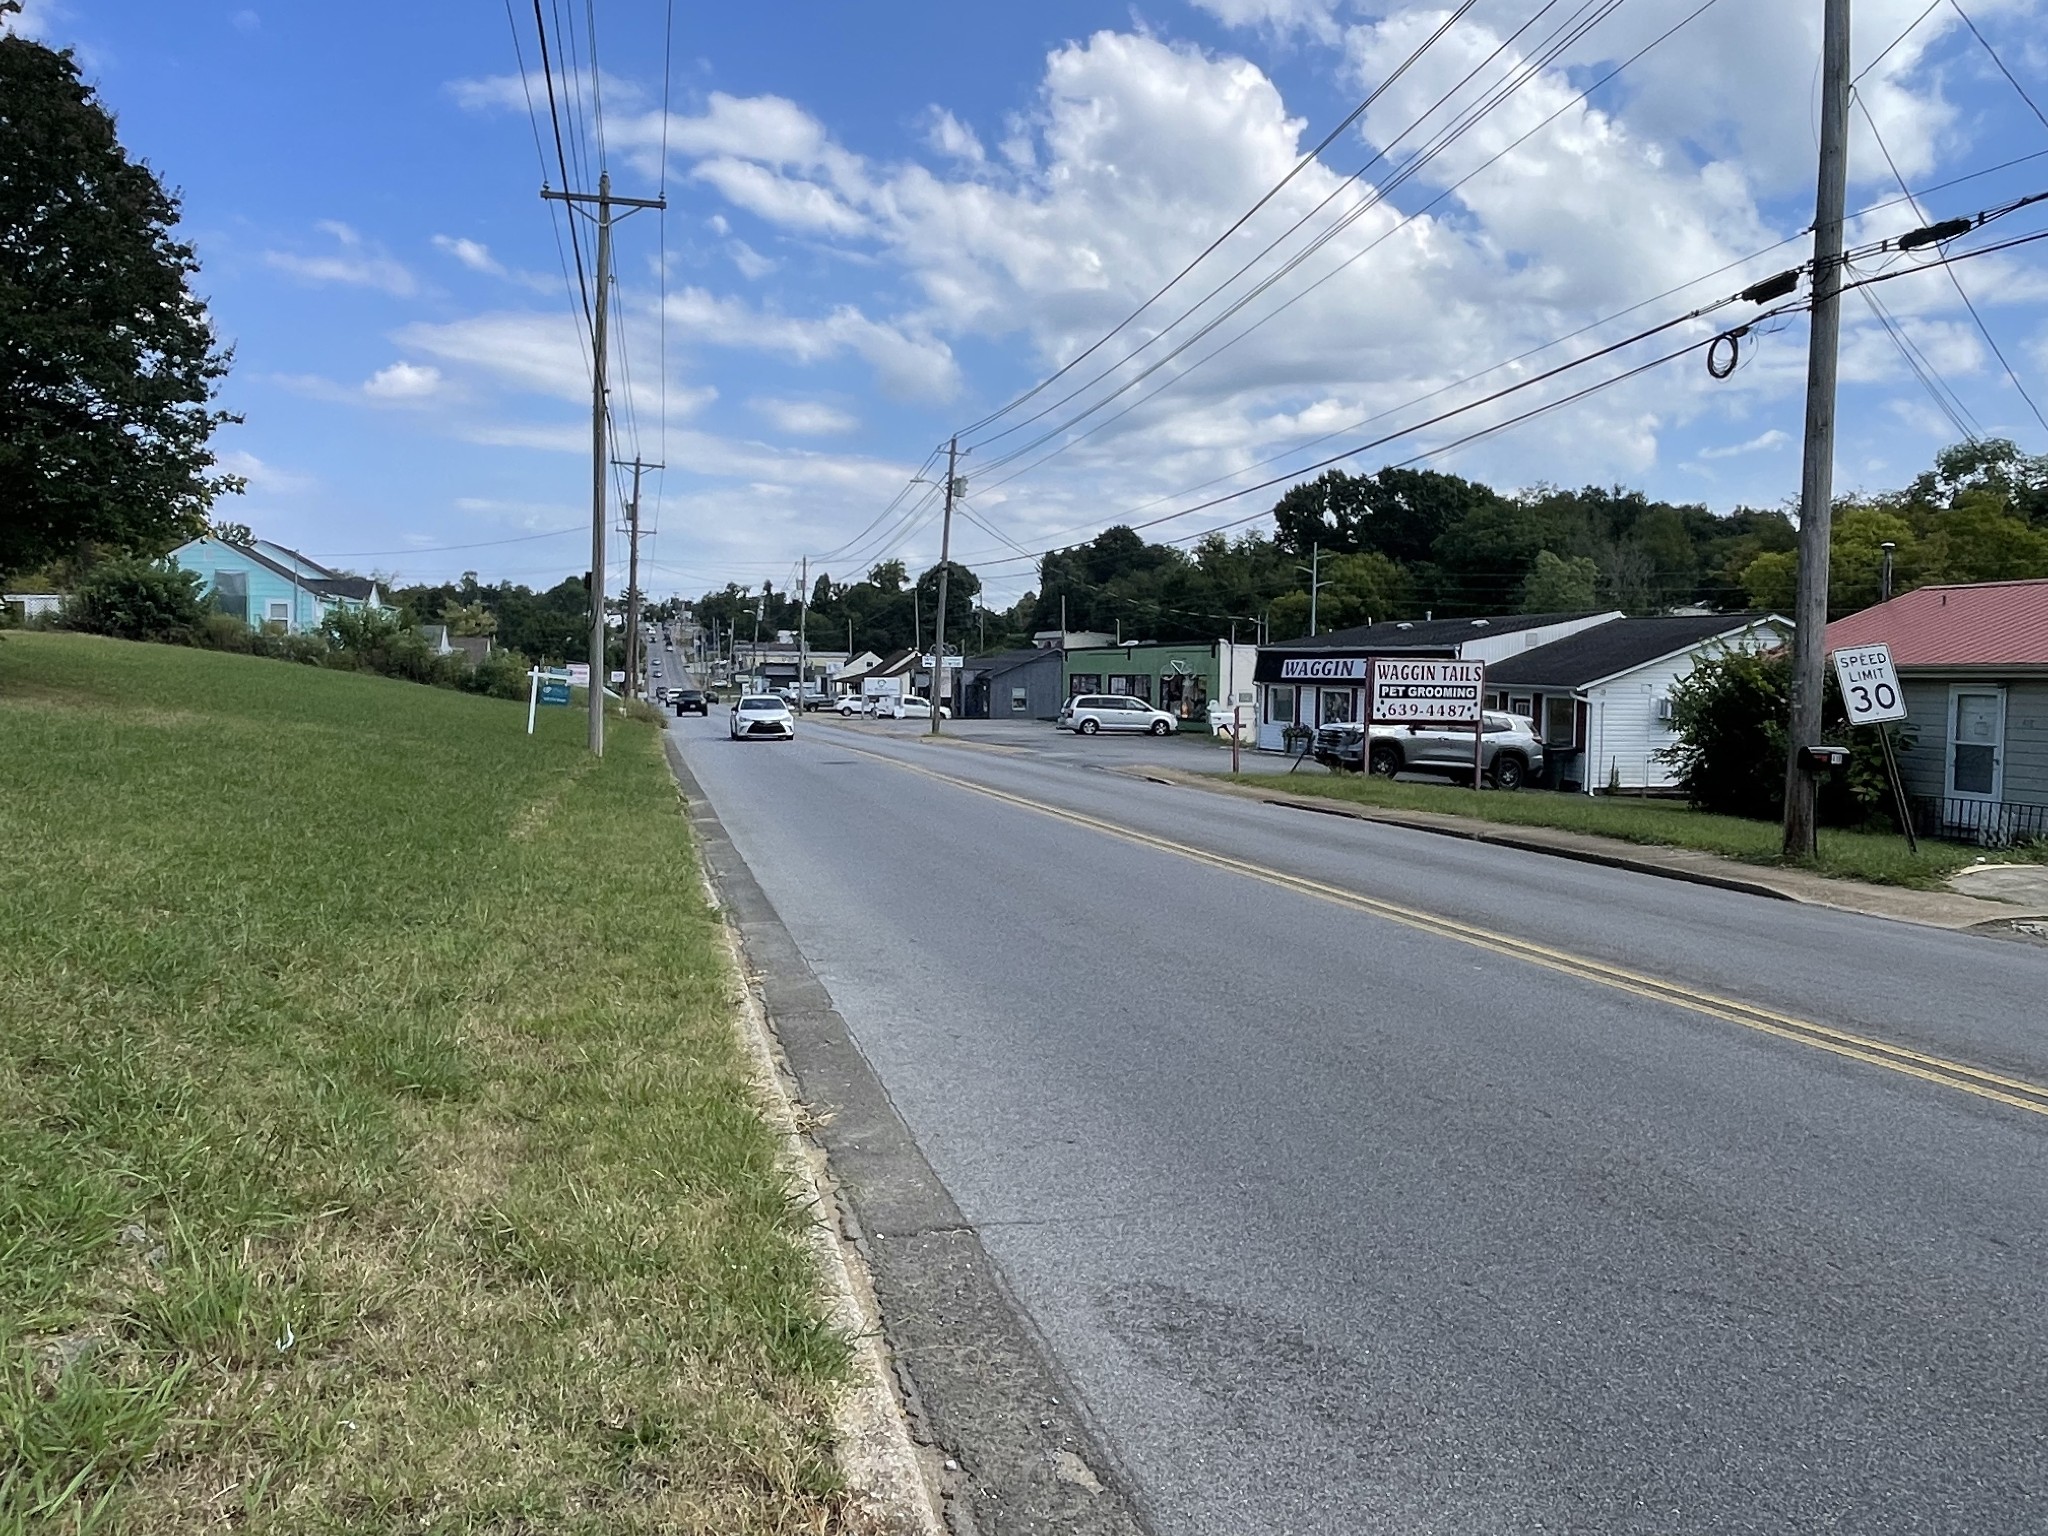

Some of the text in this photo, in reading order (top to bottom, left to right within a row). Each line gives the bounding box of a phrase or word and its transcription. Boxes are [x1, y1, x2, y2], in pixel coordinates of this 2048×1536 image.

[1840, 653, 1887, 668] SPEED
[1285, 660, 1354, 677] WAGGIN
[1377, 664, 1435, 681] WAGGIN
[1441, 665, 1482, 682] TAILS
[1848, 668, 1885, 682] LIMIT
[1381, 685, 1475, 698] PET GROOMING
[1850, 683, 1896, 713] 30
[1387, 703, 1466, 717] 639-4487
